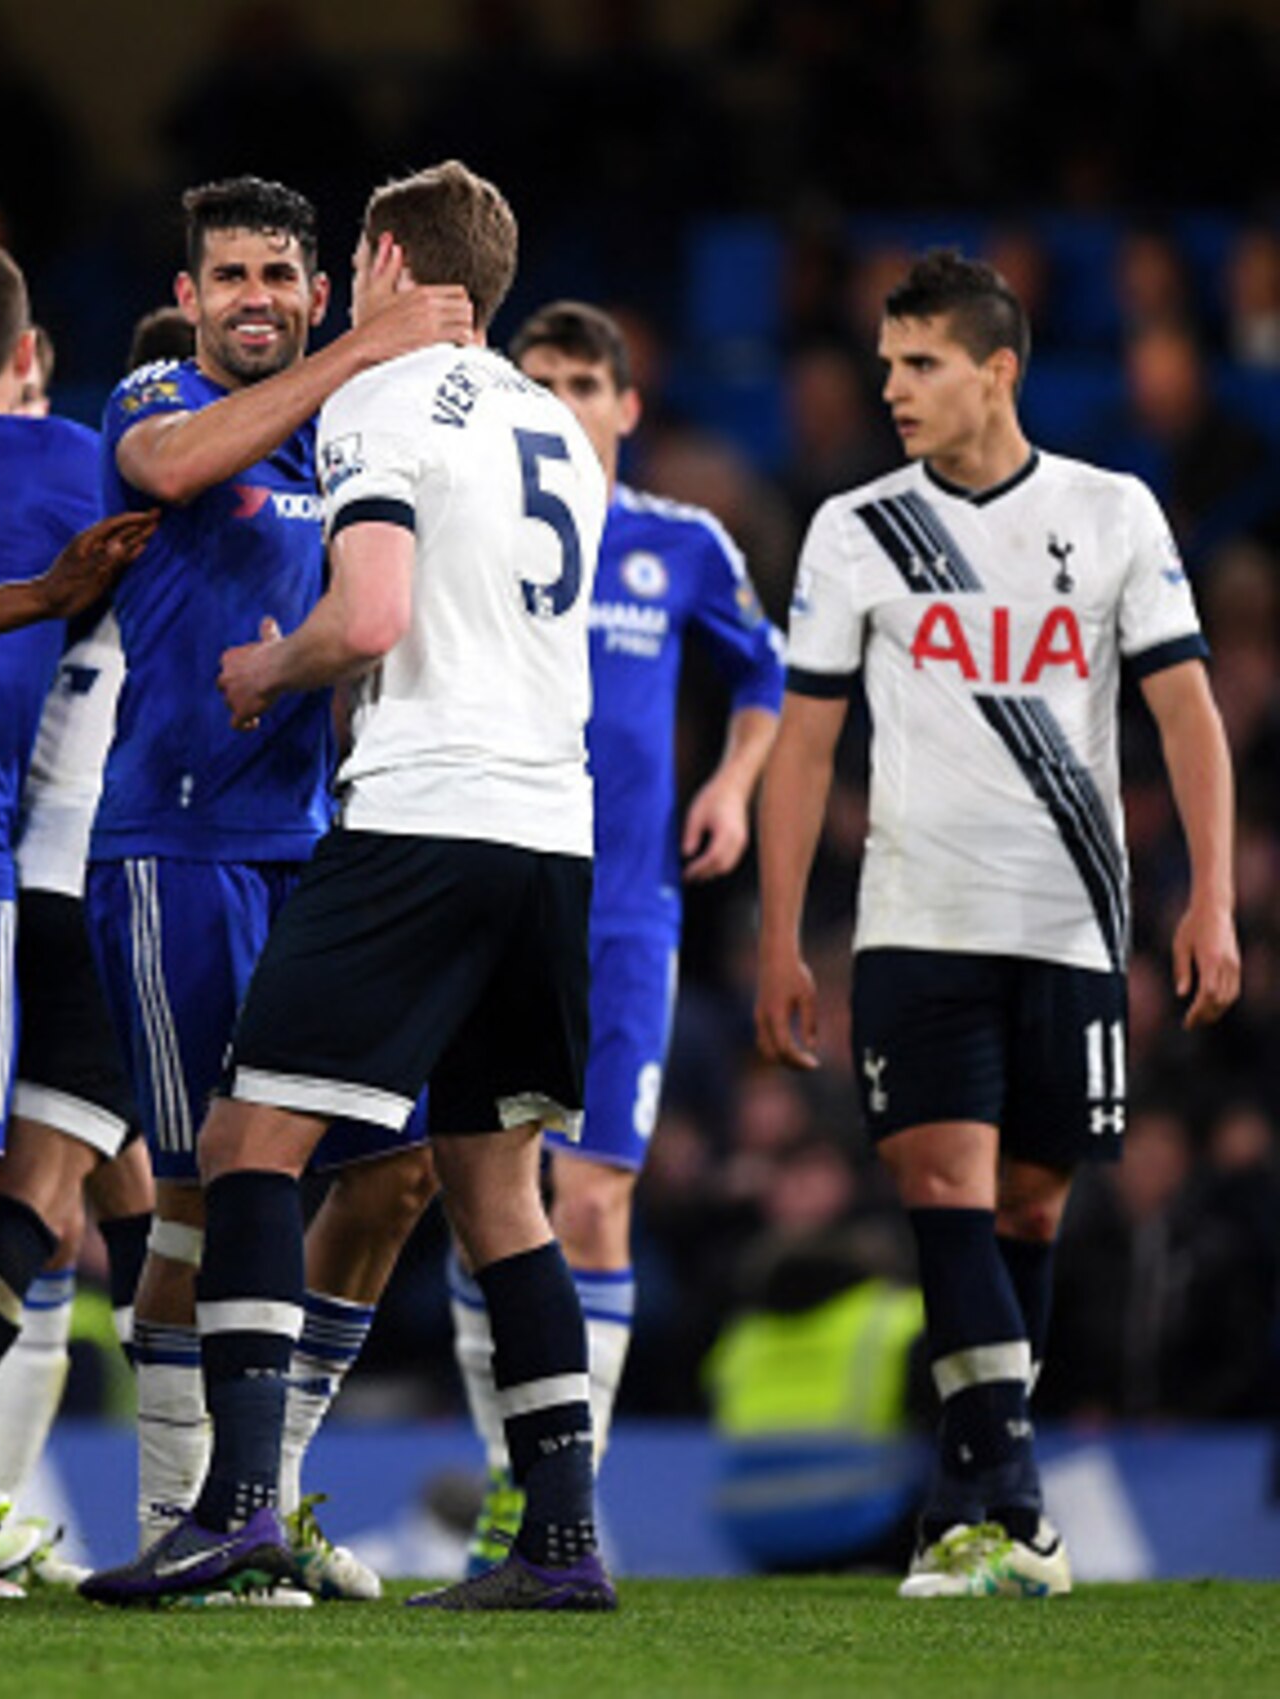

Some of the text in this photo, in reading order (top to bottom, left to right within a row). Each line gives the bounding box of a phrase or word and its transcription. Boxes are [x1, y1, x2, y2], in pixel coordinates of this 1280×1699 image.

[513, 426, 581, 616] 5
[910, 603, 1090, 684] AIA
[1084, 1019, 1125, 1099] 11
